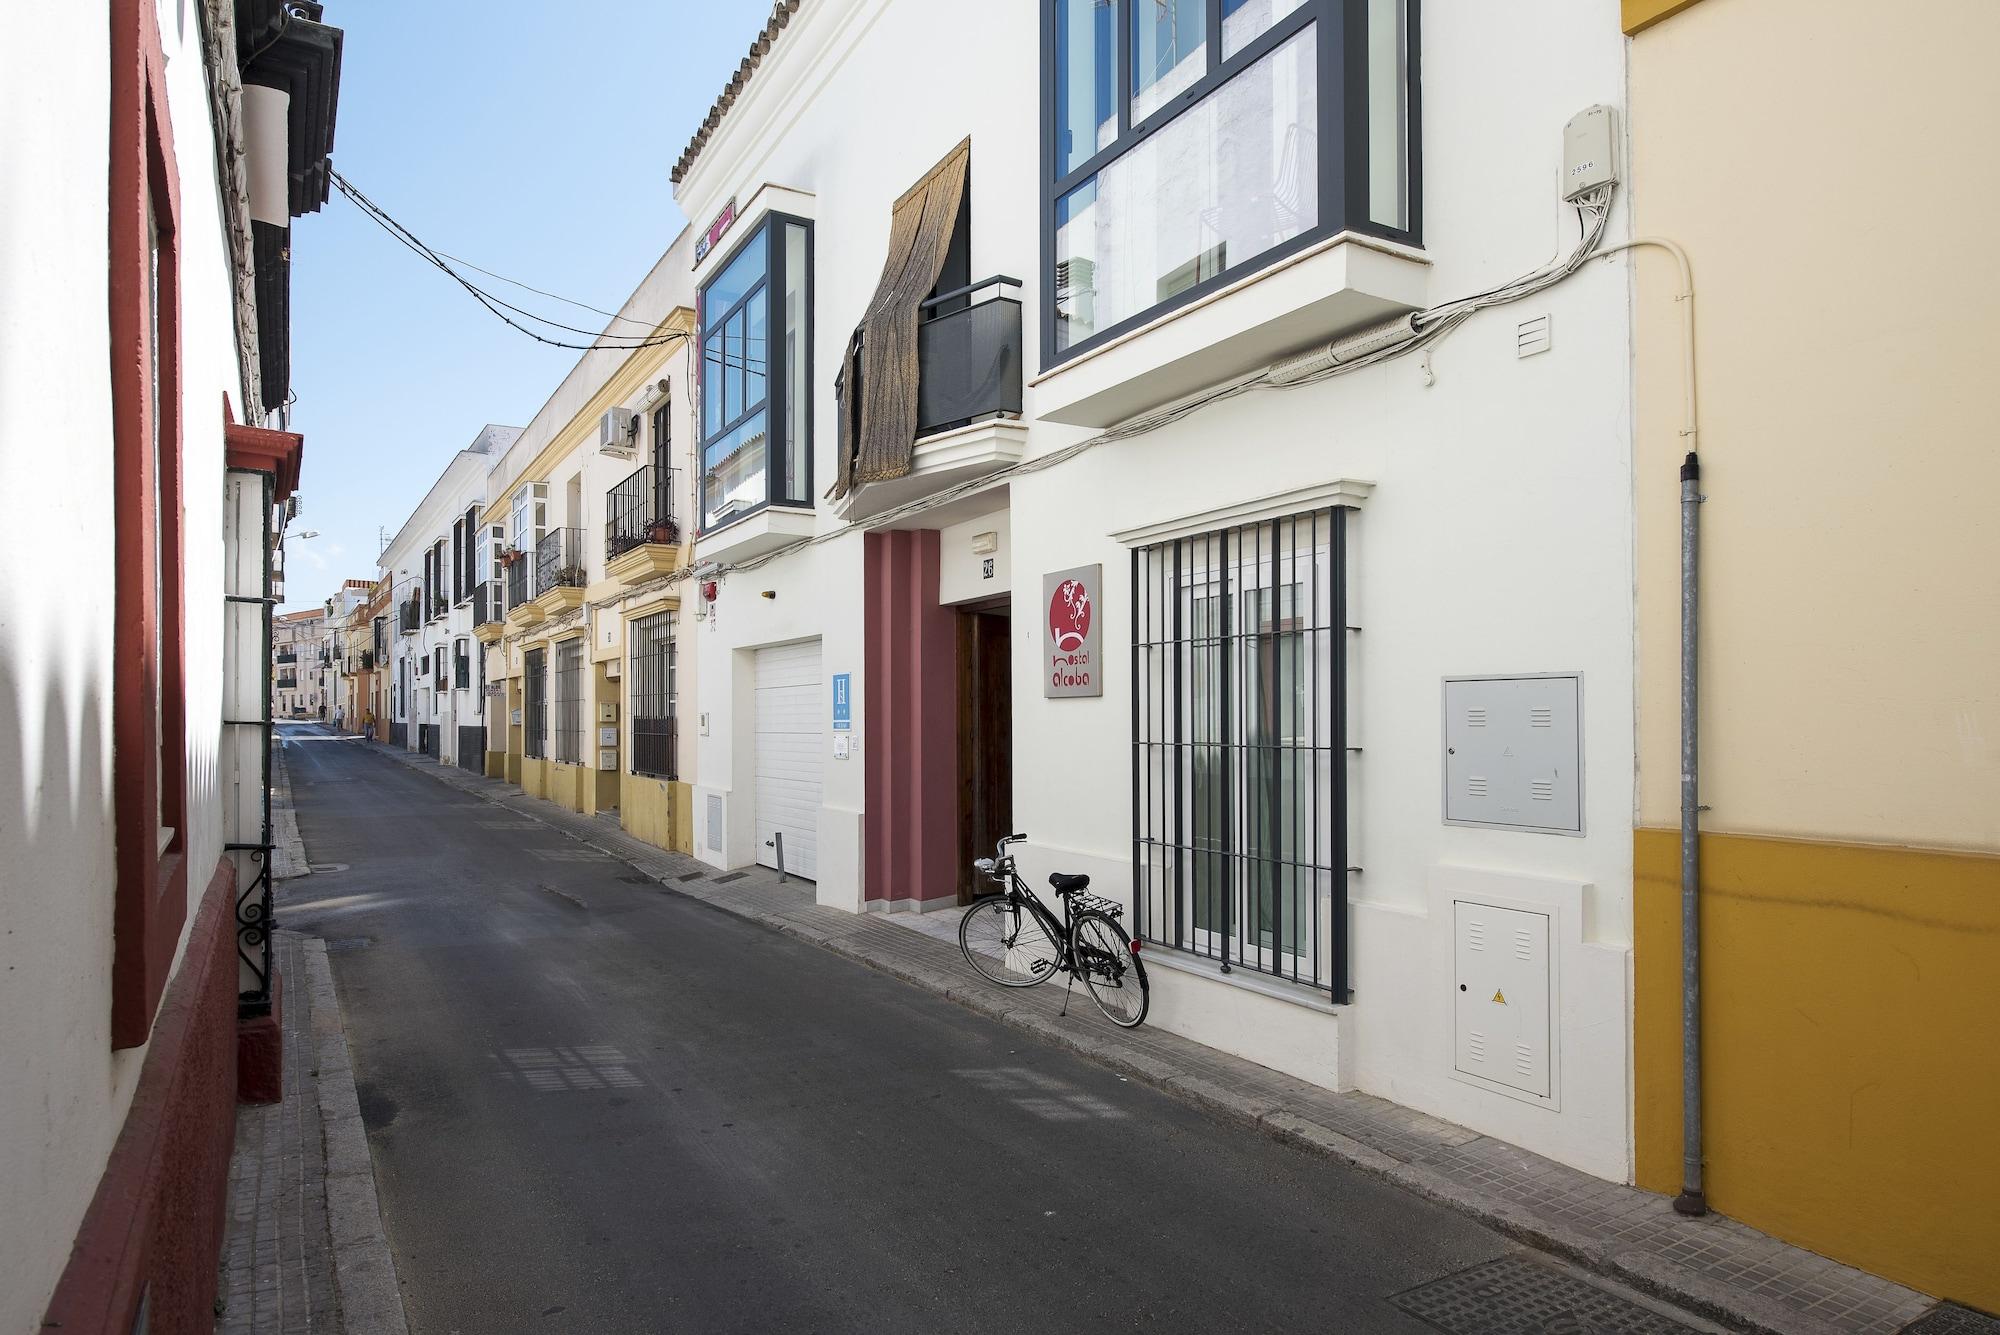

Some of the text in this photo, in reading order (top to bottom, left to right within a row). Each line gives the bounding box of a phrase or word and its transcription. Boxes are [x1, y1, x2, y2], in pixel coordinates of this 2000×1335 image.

[1572, 161, 1594, 176] 2596
[985, 561, 993, 576] 26
[1053, 650, 1089, 667] hostal
[1053, 667, 1089, 687] alcoba
